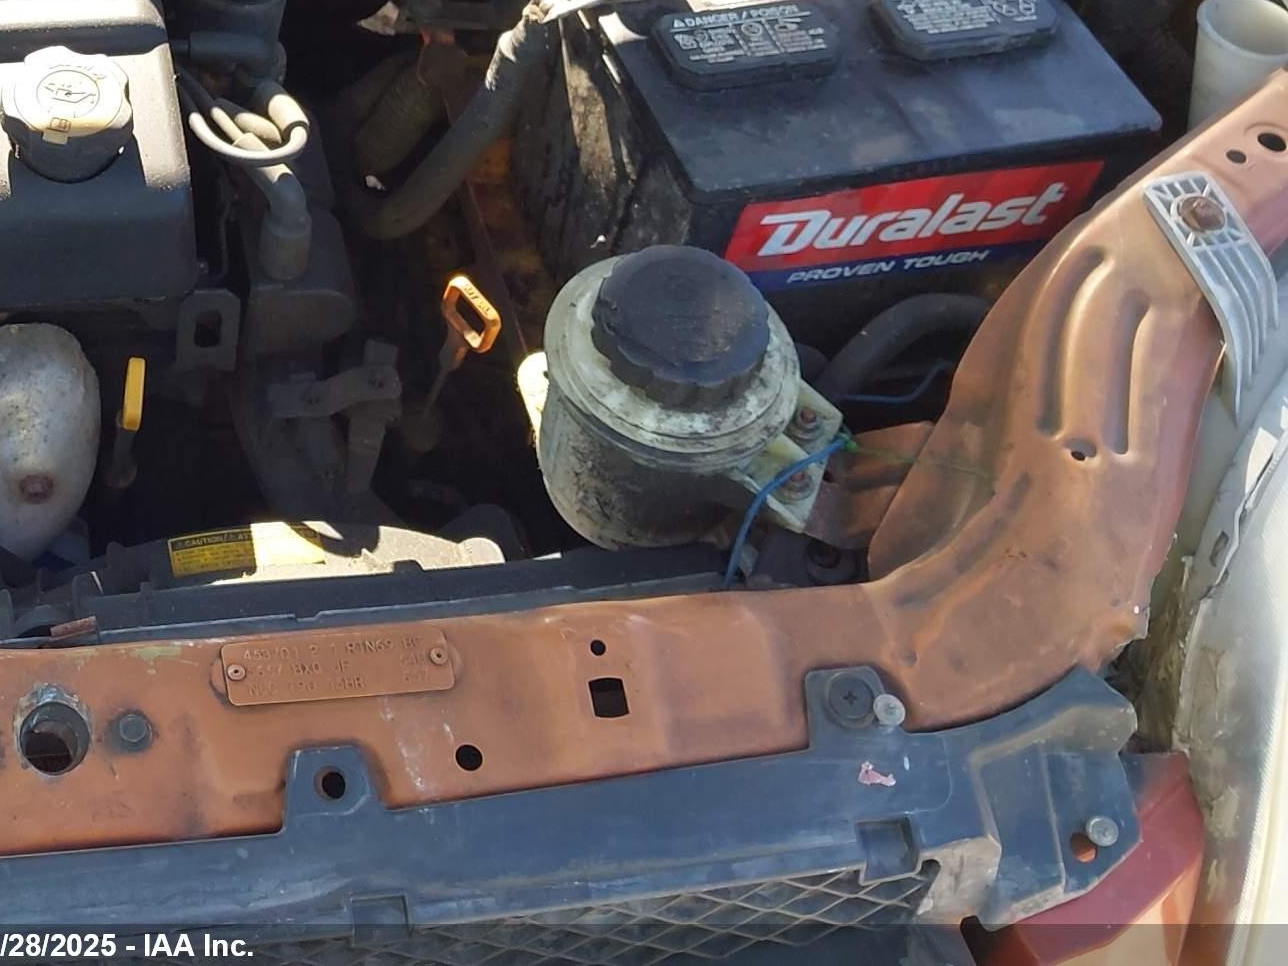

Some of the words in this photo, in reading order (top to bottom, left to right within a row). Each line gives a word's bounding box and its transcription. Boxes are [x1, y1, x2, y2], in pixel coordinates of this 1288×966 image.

[684, 12, 738, 27] DANGER
[757, 182, 1068, 257] Duralast
[786, 259, 895, 284] PROVEN
[903, 249, 991, 270] TOUGH
